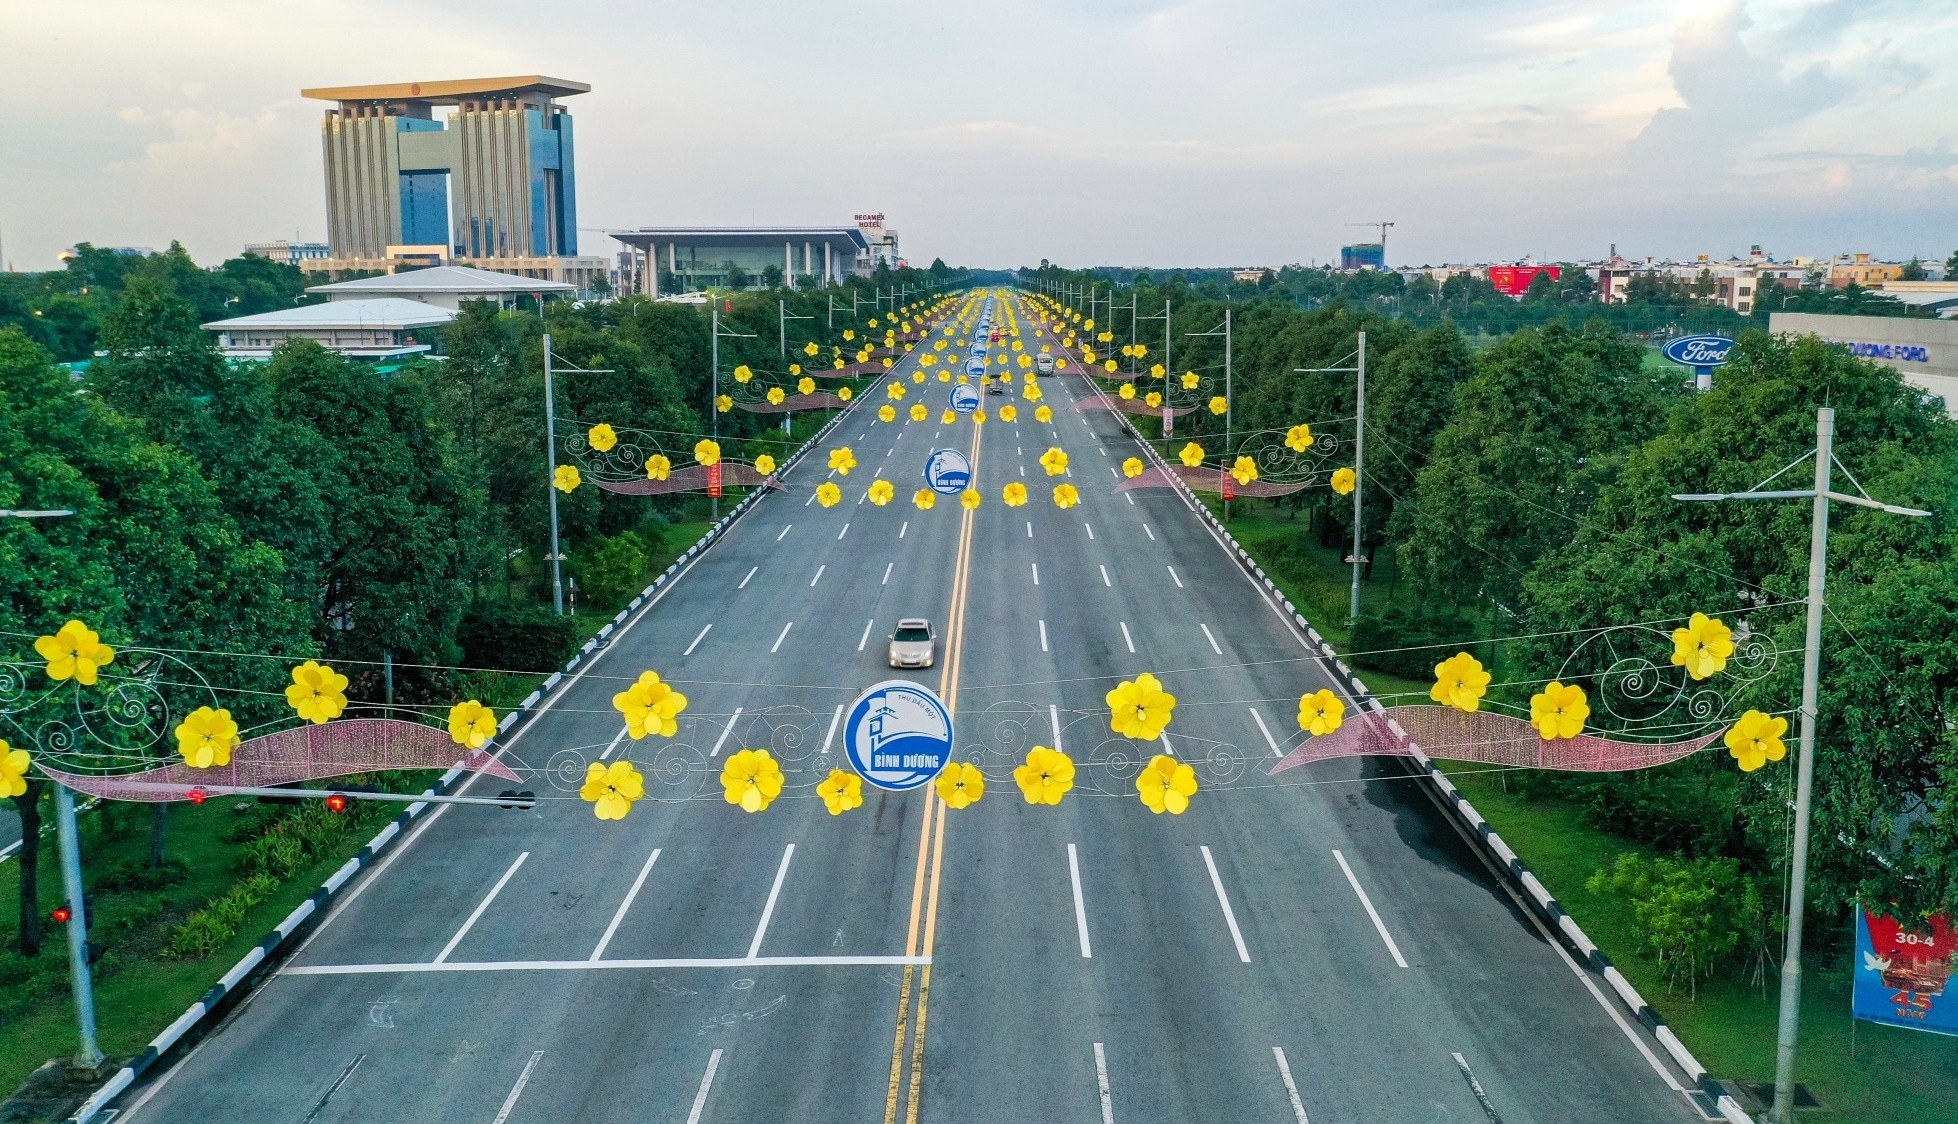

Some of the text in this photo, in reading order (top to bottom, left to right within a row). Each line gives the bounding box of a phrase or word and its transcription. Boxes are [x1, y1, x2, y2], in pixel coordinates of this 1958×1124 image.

[1681, 340, 1732, 361] Ford
[1894, 345, 1927, 362] FORD
[874, 751, 939, 769] BÌNH DƯƠNG
[1895, 932, 1935, 947] 30-4
[1889, 989, 1933, 1011] 45
